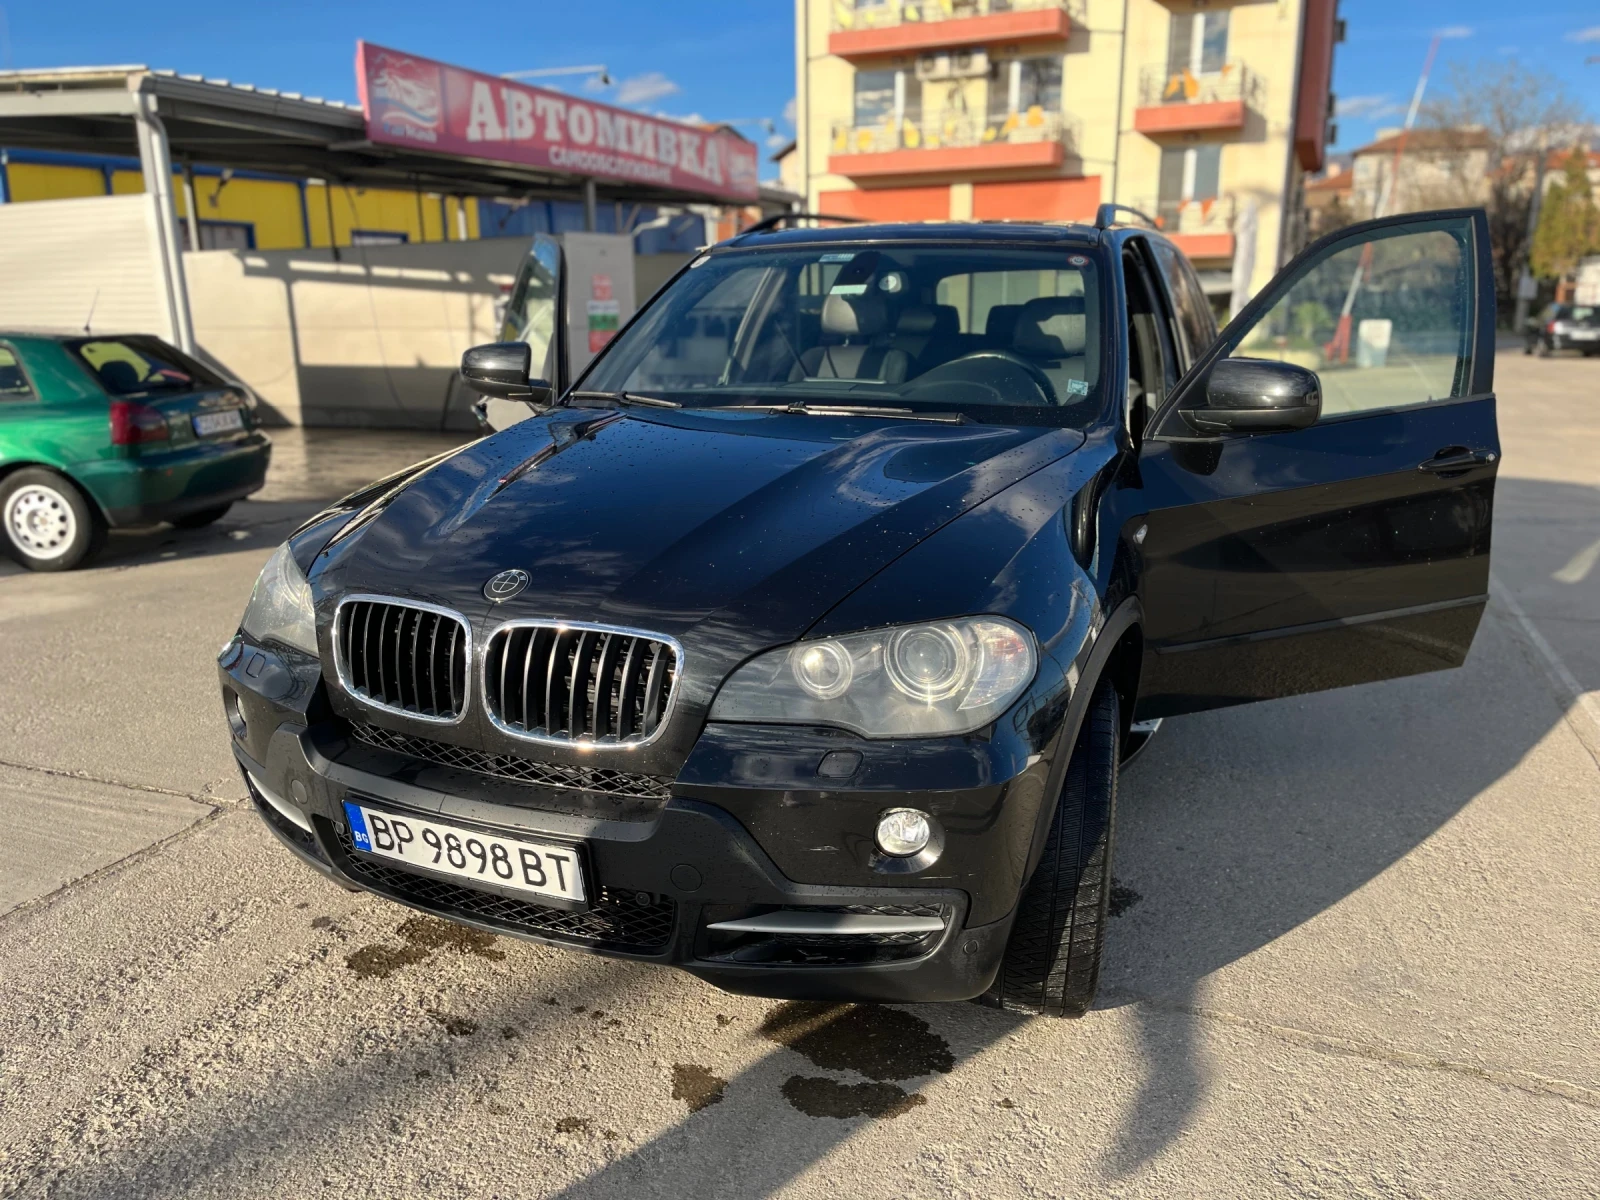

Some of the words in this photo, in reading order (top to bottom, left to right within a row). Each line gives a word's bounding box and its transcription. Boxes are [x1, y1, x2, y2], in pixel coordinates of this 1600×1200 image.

[465, 81, 722, 184] АВТОМИВКА
[354, 830, 369, 844] BG
[368, 813, 414, 852] BP
[422, 827, 513, 879] 9898
[518, 848, 570, 891] BT
